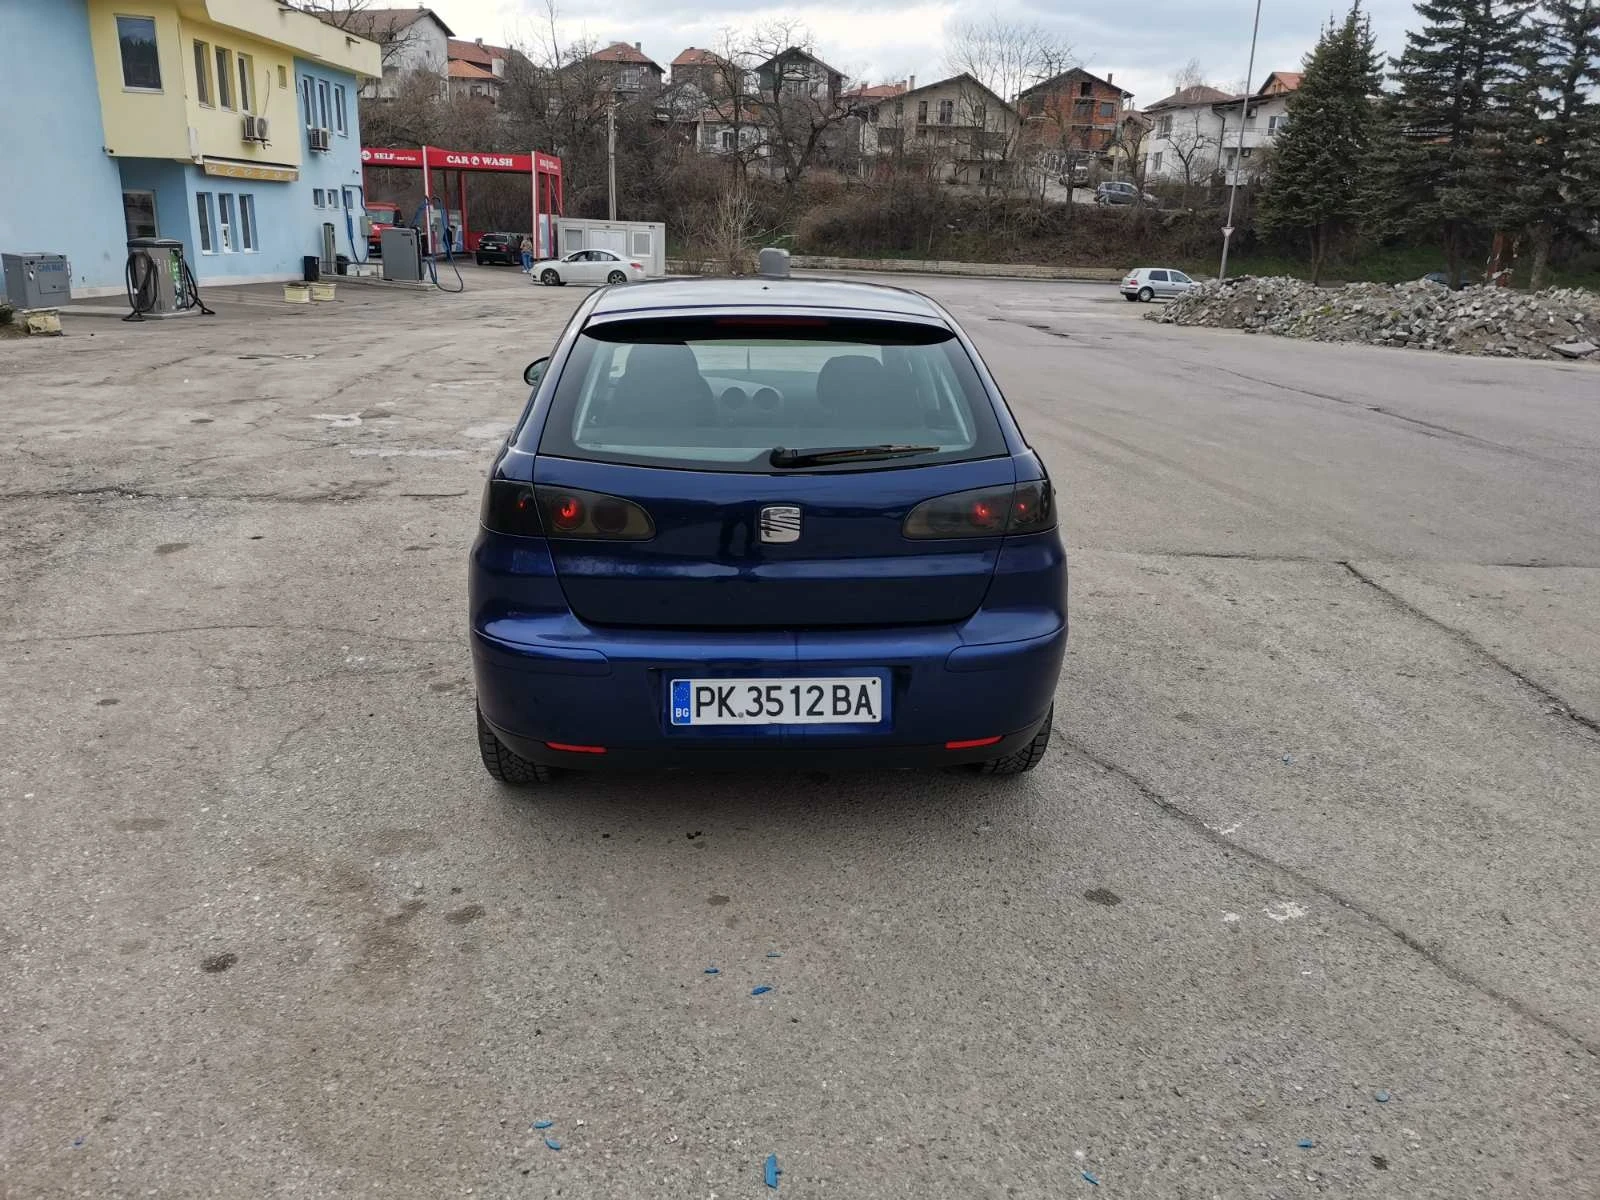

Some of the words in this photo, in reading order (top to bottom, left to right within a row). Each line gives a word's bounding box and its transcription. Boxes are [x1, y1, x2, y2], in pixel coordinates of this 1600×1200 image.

[446, 155, 470, 165] CAR
[482, 157, 513, 167] WASH
[675, 707, 690, 718] BG
